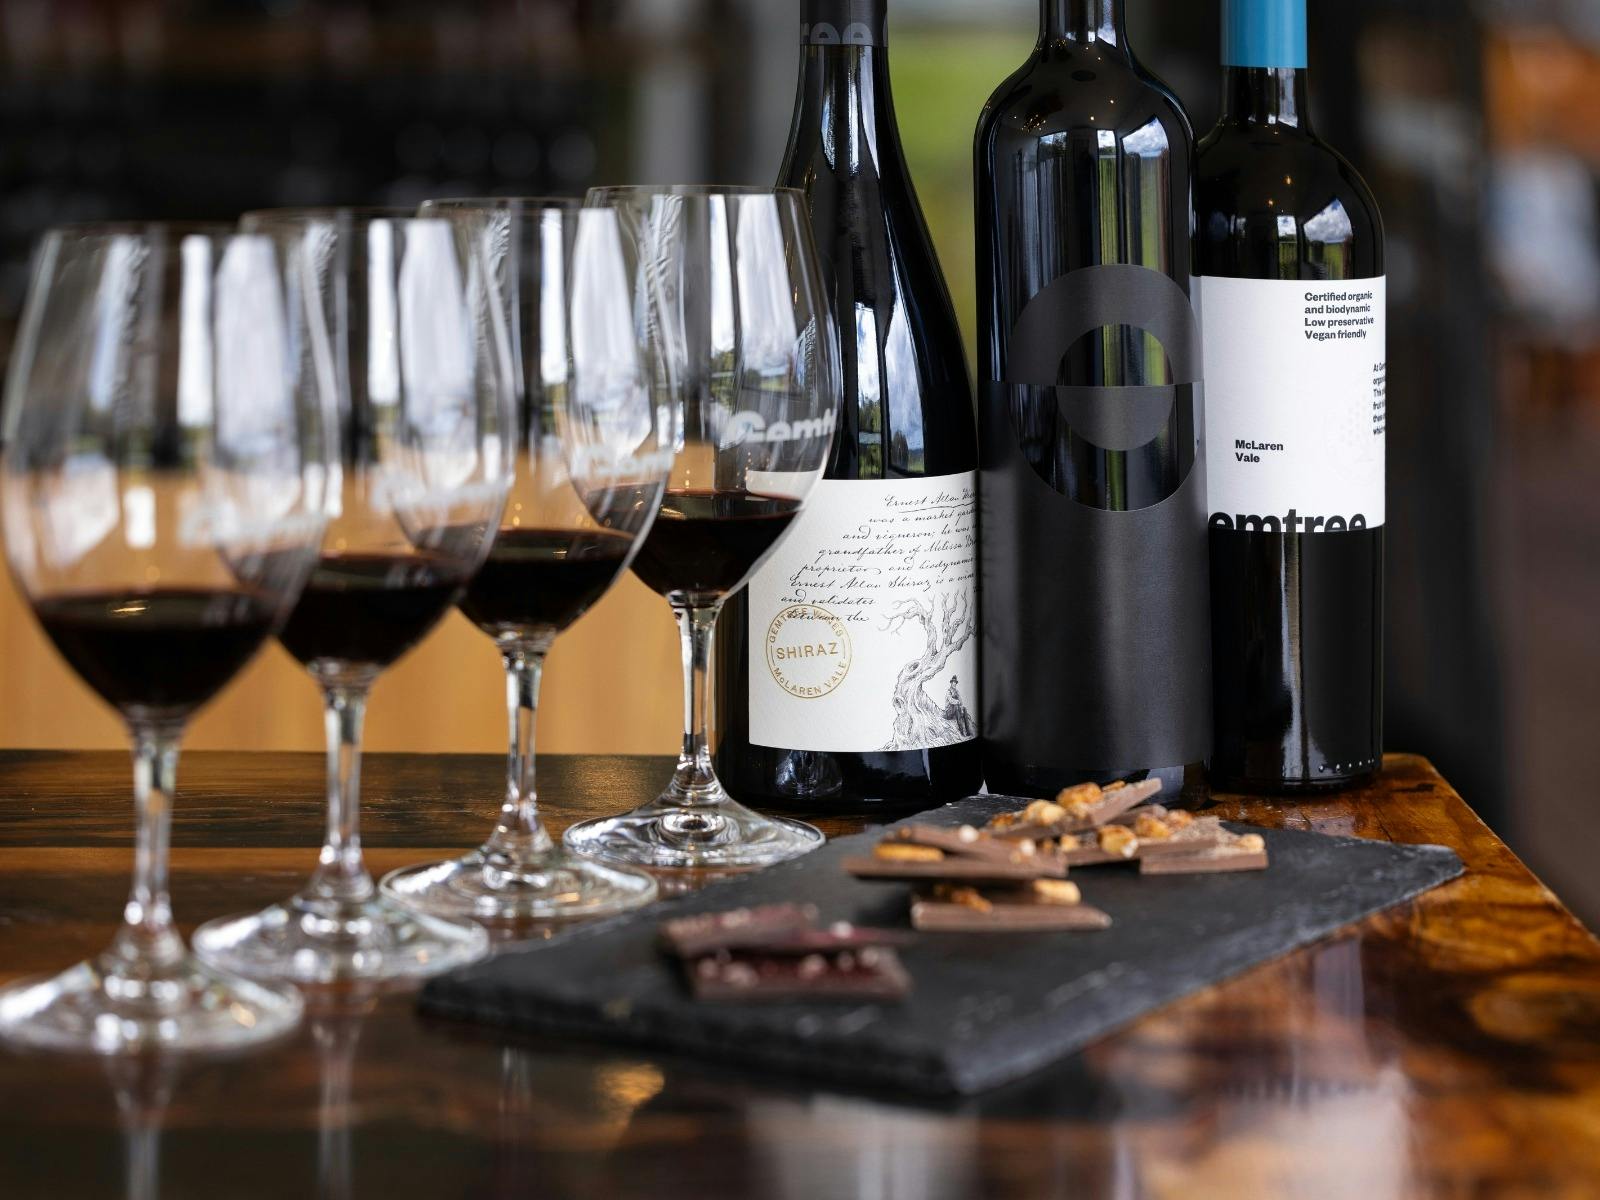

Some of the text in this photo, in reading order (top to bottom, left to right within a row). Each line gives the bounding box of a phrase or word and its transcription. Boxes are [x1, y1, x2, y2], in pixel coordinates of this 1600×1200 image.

[1304, 290, 1373, 303] Certified organic
[1304, 304, 1371, 315] and biodynamic
[1304, 316, 1375, 329] Low preservative
[1304, 329, 1367, 341] Vegan friendly
[1235, 439, 1284, 451] McLaren
[1235, 452, 1260, 463] Vale
[842, 525, 871, 540] and
[814, 543, 904, 565] grandfather
[780, 589, 807, 604] and
[845, 610, 870, 622] the
[776, 642, 839, 661] SHIRAZ
[823, 661, 847, 689] VALE
